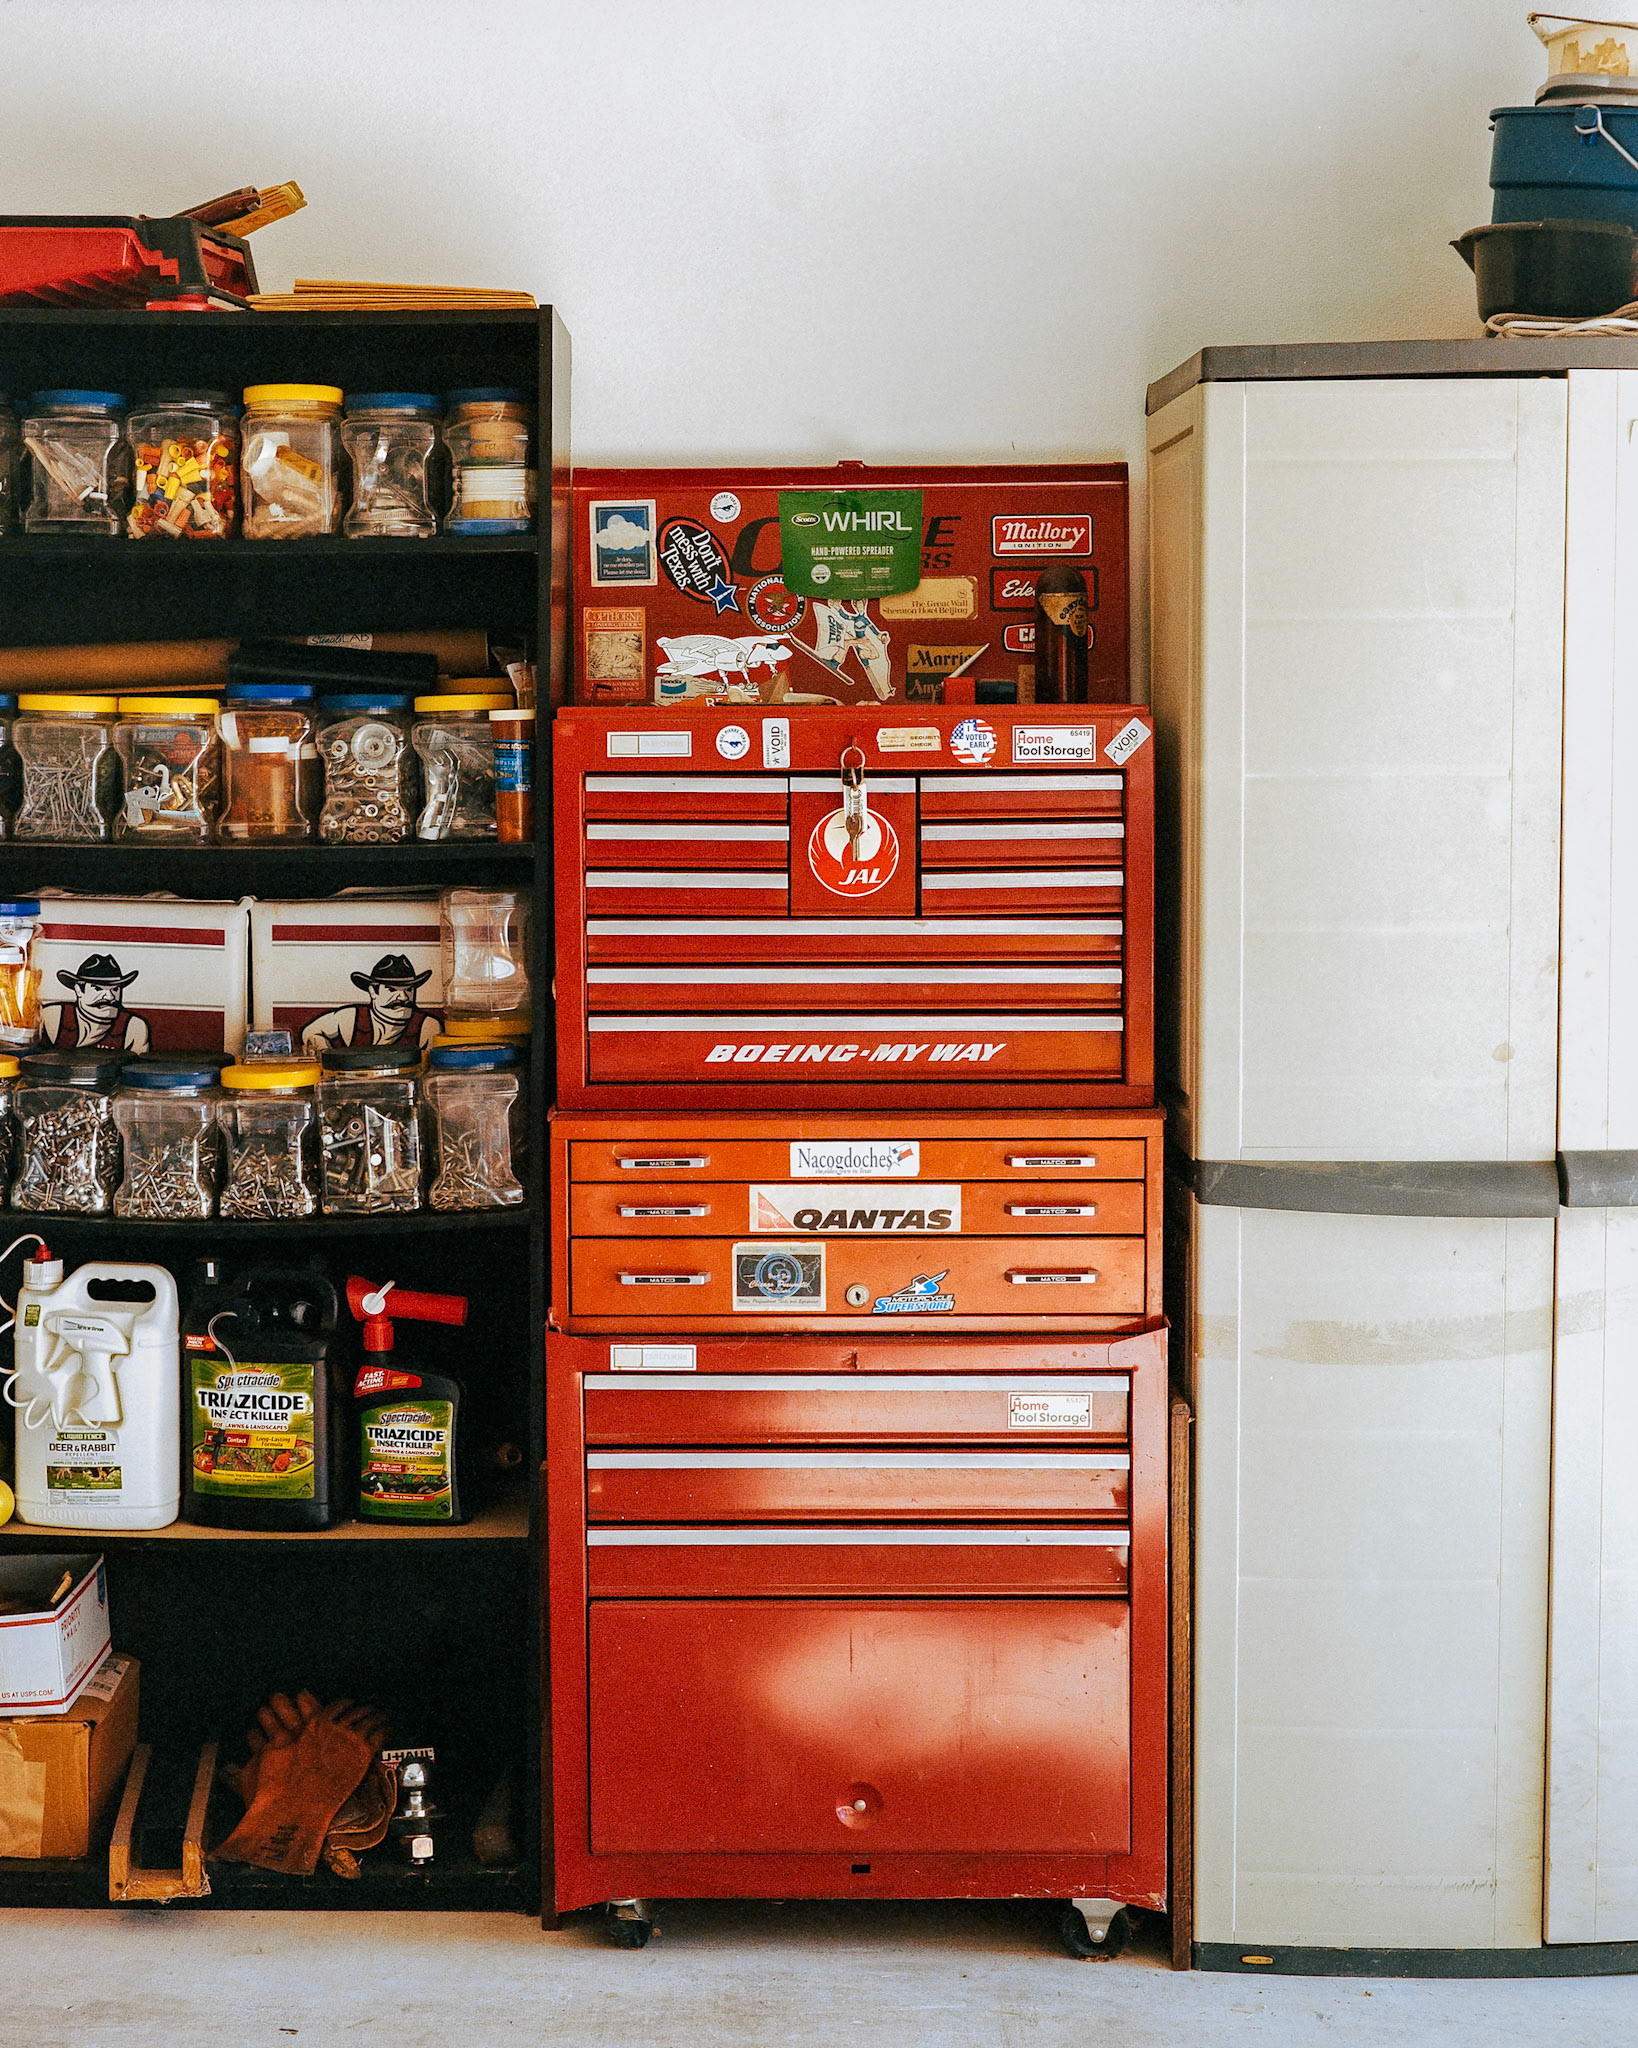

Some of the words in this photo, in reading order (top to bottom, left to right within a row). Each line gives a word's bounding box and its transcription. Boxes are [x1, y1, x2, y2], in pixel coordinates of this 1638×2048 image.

[822, 511, 913, 532] WHIRL
[1002, 522, 1086, 542] Mallory
[811, 546, 861, 556] HAND-POWERED
[862, 545, 894, 556] SPREADER
[669, 526, 698, 560] mess
[688, 559, 712, 590] with
[660, 543, 691, 590] Texas.
[749, 577, 784, 604] NATIONAL
[586, 610, 642, 620] COPTHORNE
[939, 607, 968, 615] Beijing
[752, 612, 802, 632] ASSOCIATION
[771, 726, 781, 755] VOID
[965, 733, 988, 741] VOTED
[1017, 734, 1054, 744] Home
[1114, 728, 1139, 752] VOID
[1017, 746, 1041, 756] Tool
[1043, 746, 1091, 758] Storage
[838, 868, 882, 885] JAL
[928, 1043, 1007, 1062] WAY
[798, 1146, 893, 1171] Nacogdoches
[793, 1209, 952, 1231] QANTAS
[891, 1294, 954, 1303] MOTORCYCLE
[364, 1371, 385, 1380] FAST-
[357, 1377, 384, 1388] ACTING
[1013, 1401, 1049, 1411] Home
[251, 1411, 289, 1421] KILLER
[380, 1412, 432, 1425] Spectracide
[1013, 1412, 1037, 1422] Tool
[1039, 1412, 1087, 1425] Storage
[367, 1427, 444, 1441] TRIAZICIDE
[49, 1443, 73, 1452] DEER
[80, 1443, 116, 1452] RABBIT
[376, 1440, 404, 1448] INSECT
[405, 1441, 433, 1449] KILLER
